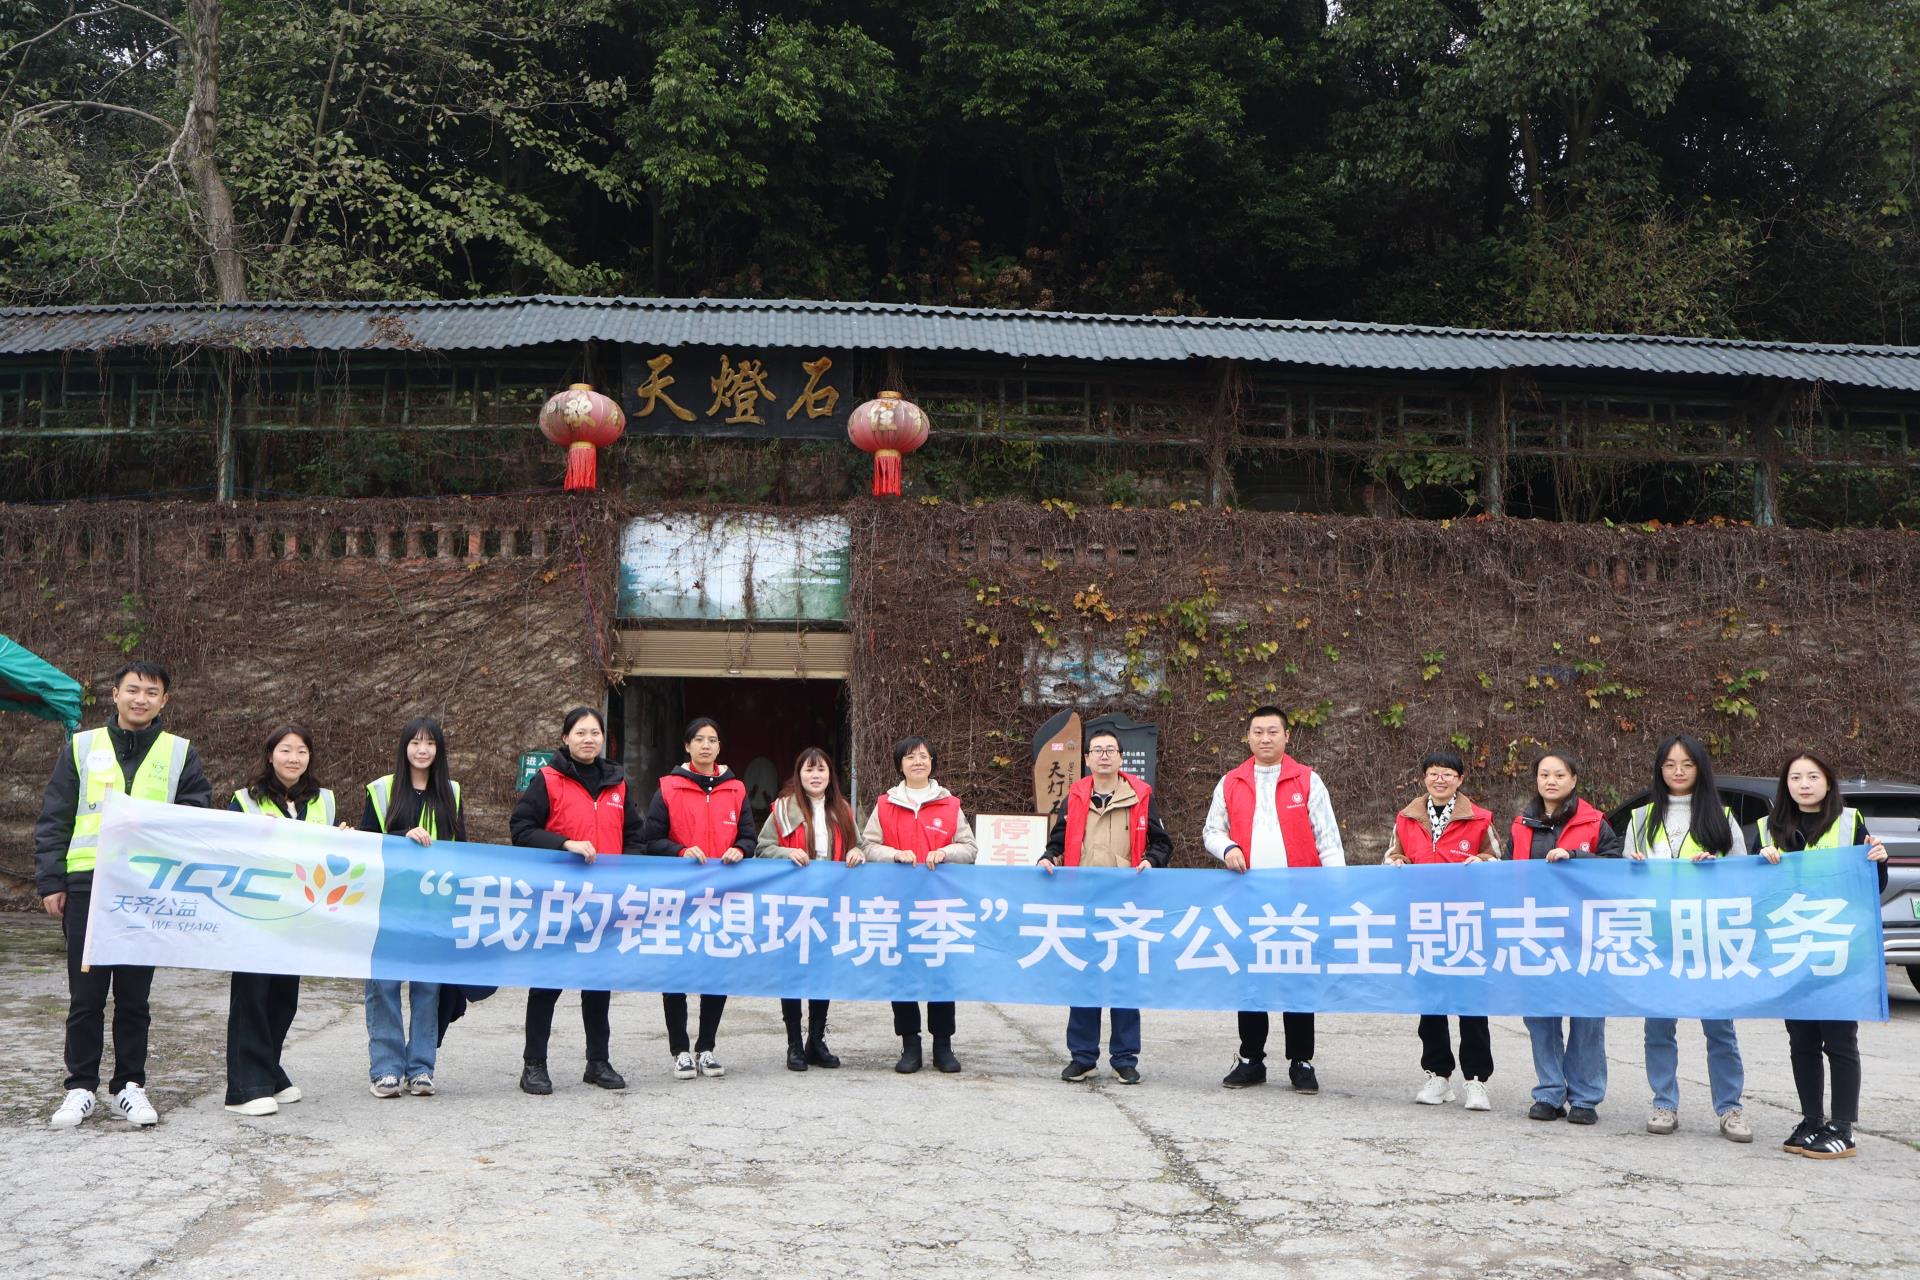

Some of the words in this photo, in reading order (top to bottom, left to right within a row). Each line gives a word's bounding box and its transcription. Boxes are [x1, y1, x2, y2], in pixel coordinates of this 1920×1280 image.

[633, 353, 840, 425] 天燈石
[110, 894, 199, 917] 天齐公益
[178, 921, 221, 933] SHARE
